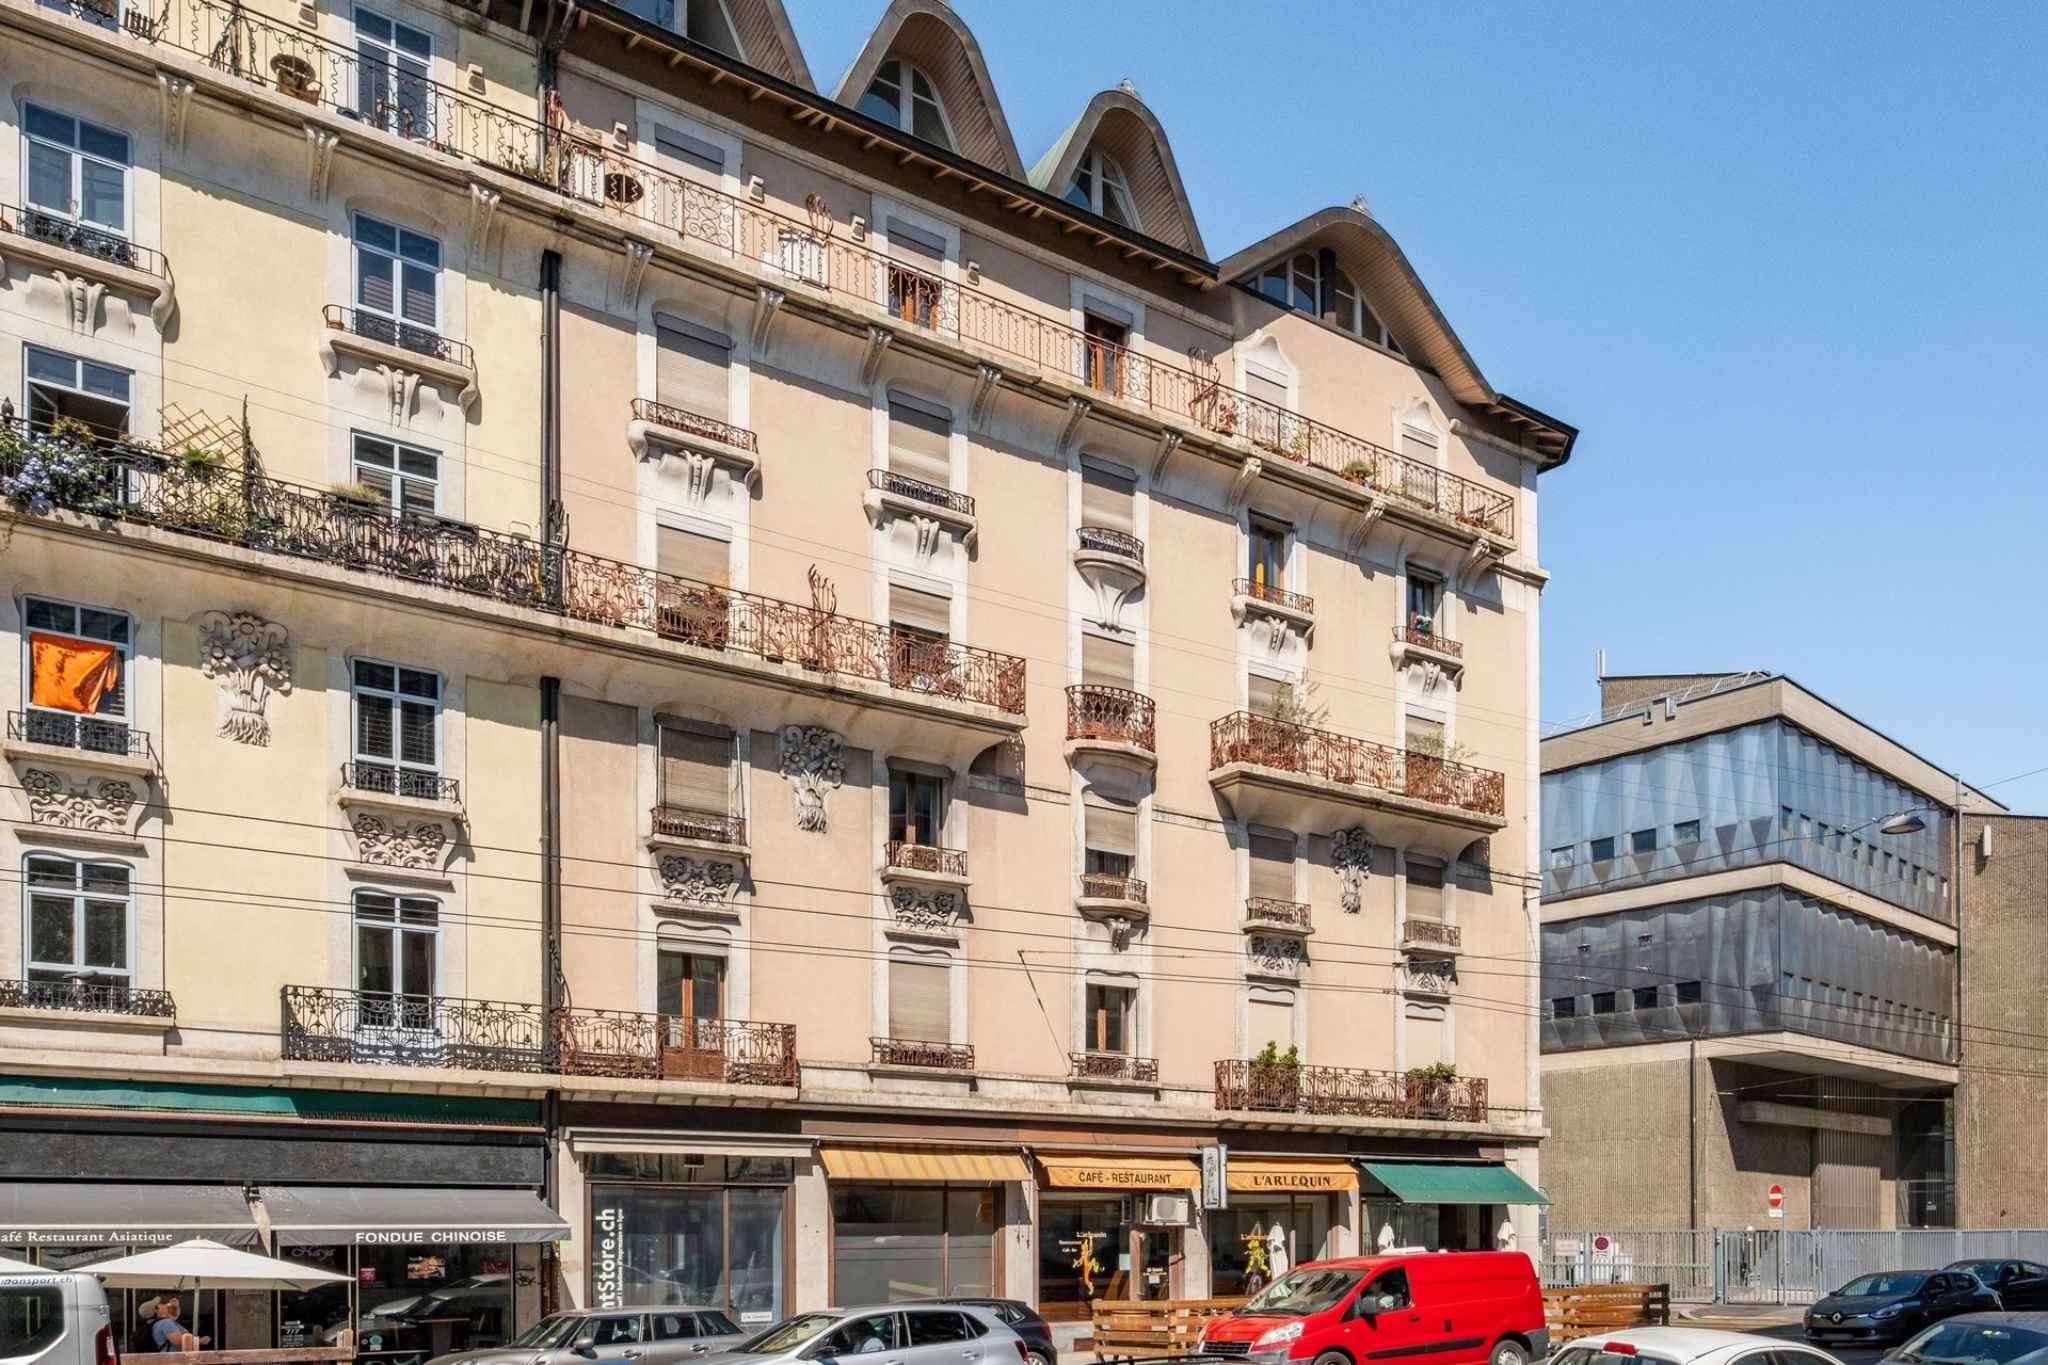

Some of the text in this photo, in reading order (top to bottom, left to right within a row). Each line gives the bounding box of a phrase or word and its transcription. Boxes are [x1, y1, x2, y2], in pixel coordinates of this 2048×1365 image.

[1078, 1172, 1104, 1183] CAFÉ
[1112, 1172, 1172, 1184] RESTAURANT
[1253, 1175, 1331, 1187] L'ARLEQUIN
[28, 1231, 104, 1242] Restaurant
[109, 1231, 173, 1244] Asiatique
[356, 1231, 507, 1242] FONDUE CHINOISE
